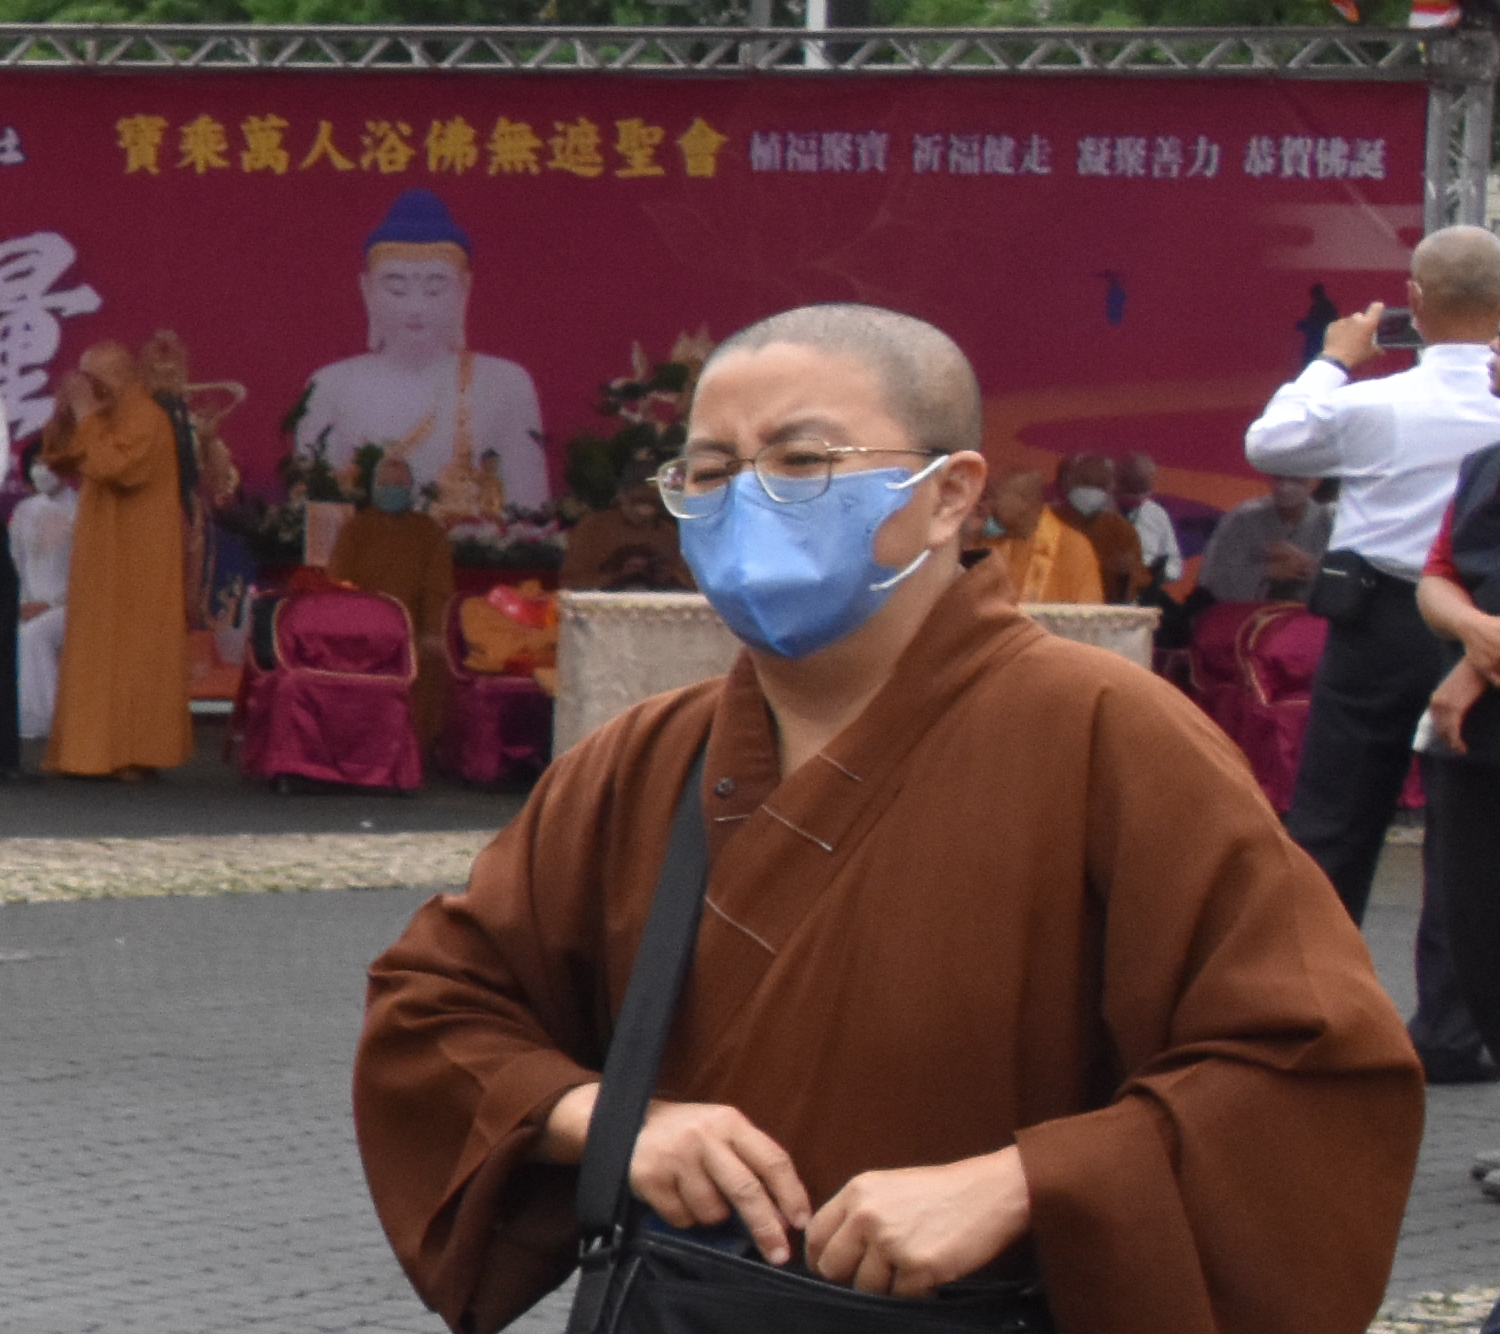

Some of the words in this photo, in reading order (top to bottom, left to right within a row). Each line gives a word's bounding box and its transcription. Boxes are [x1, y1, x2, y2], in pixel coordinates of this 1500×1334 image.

[114, 113, 729, 179] 寶乘萬人浴佛無遮聖會
[912, 133, 1052, 175] 祈福健走
[1076, 134, 1222, 179] 凝聚善力
[1243, 135, 1387, 179] 恭賀佛誕
